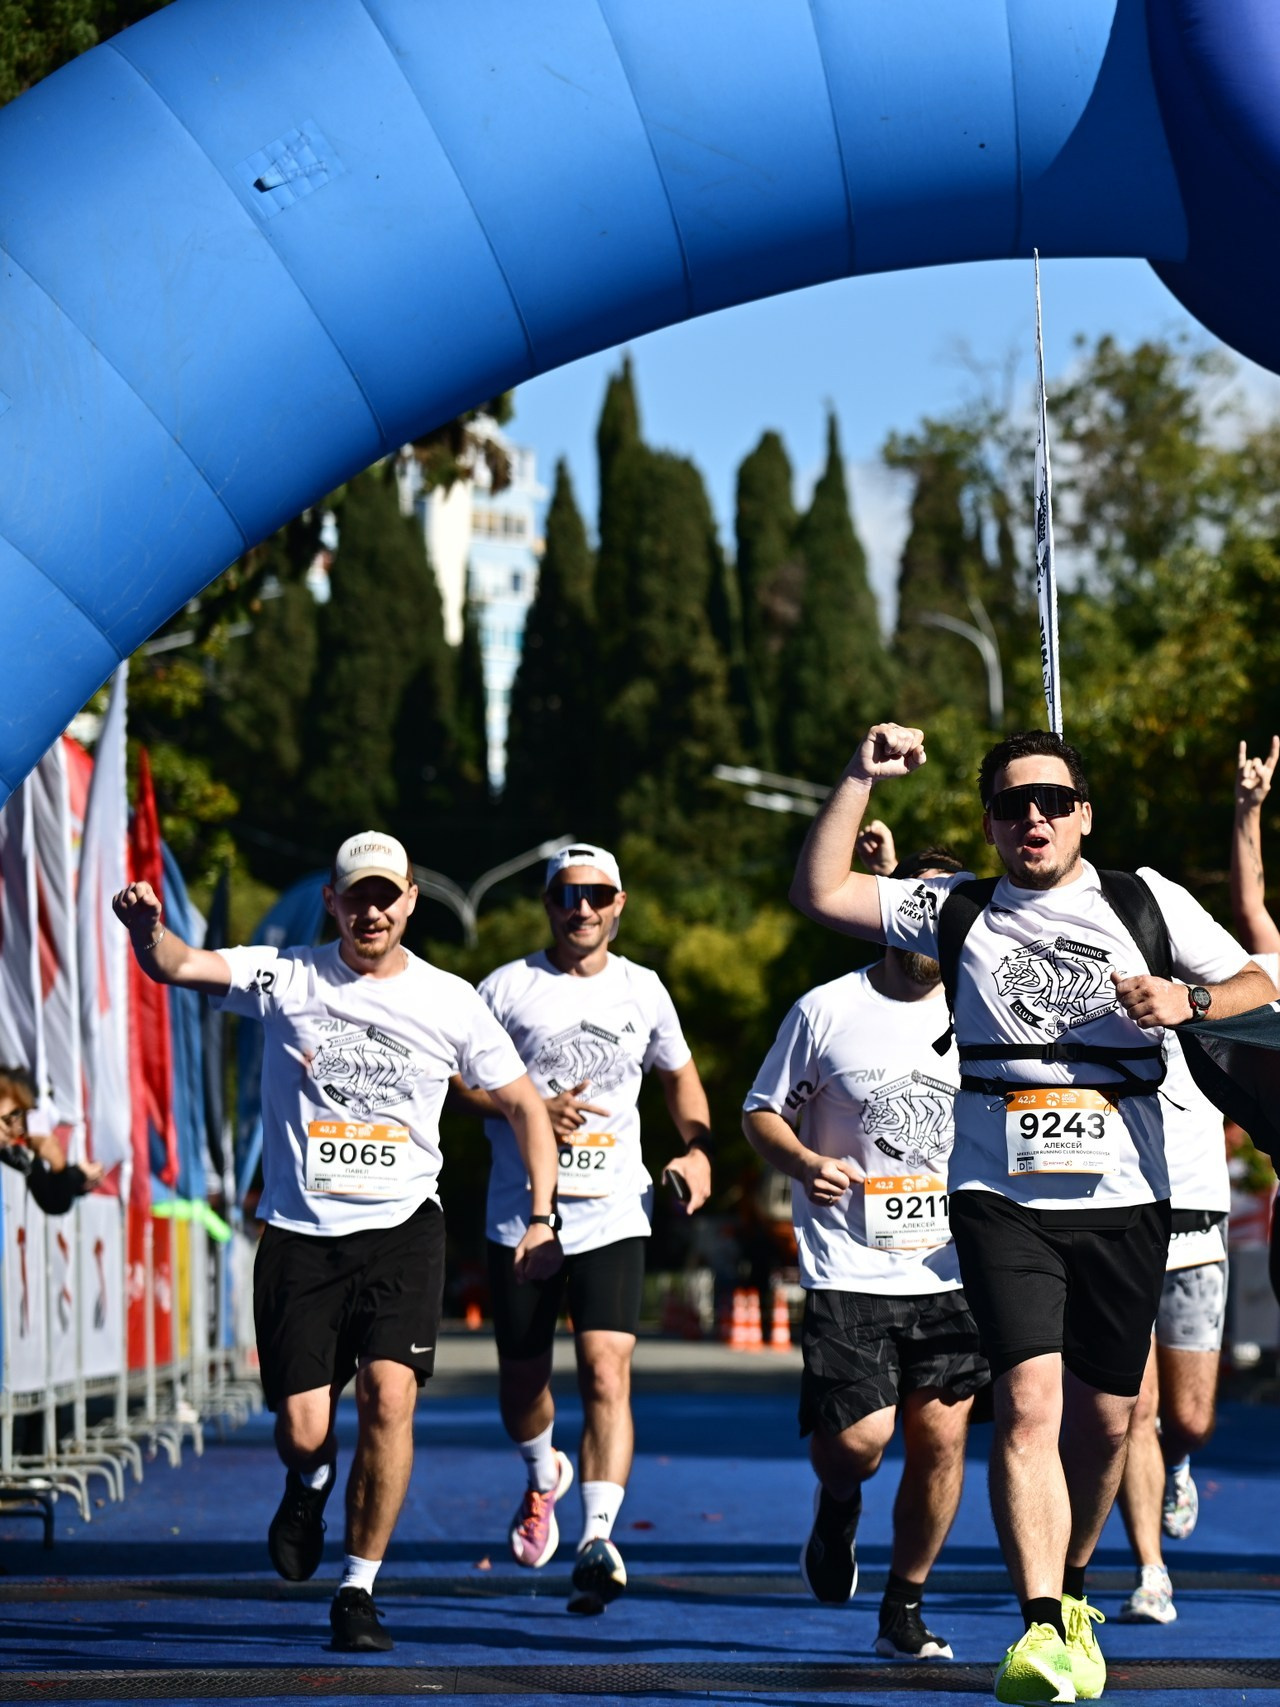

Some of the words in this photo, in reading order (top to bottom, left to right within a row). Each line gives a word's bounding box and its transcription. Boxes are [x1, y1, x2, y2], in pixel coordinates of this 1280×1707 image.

[901, 899, 918, 911] MRC
[1065, 941, 1104, 959] RUNNING
[1014, 1004, 1034, 1023] CLUB
[376, 1034, 407, 1055] RUNNING
[922, 1076, 956, 1096] RUNNING
[326, 1087, 343, 1105] CLUB
[1020, 1111, 1106, 1140] 9243
[320, 1141, 396, 1168] 9065
[878, 1140, 896, 1157] CLUB
[1043, 1141, 1082, 1149] АЛЕКСЕЙ
[558, 1150, 606, 1170] 082
[885, 1194, 949, 1220] 9211
